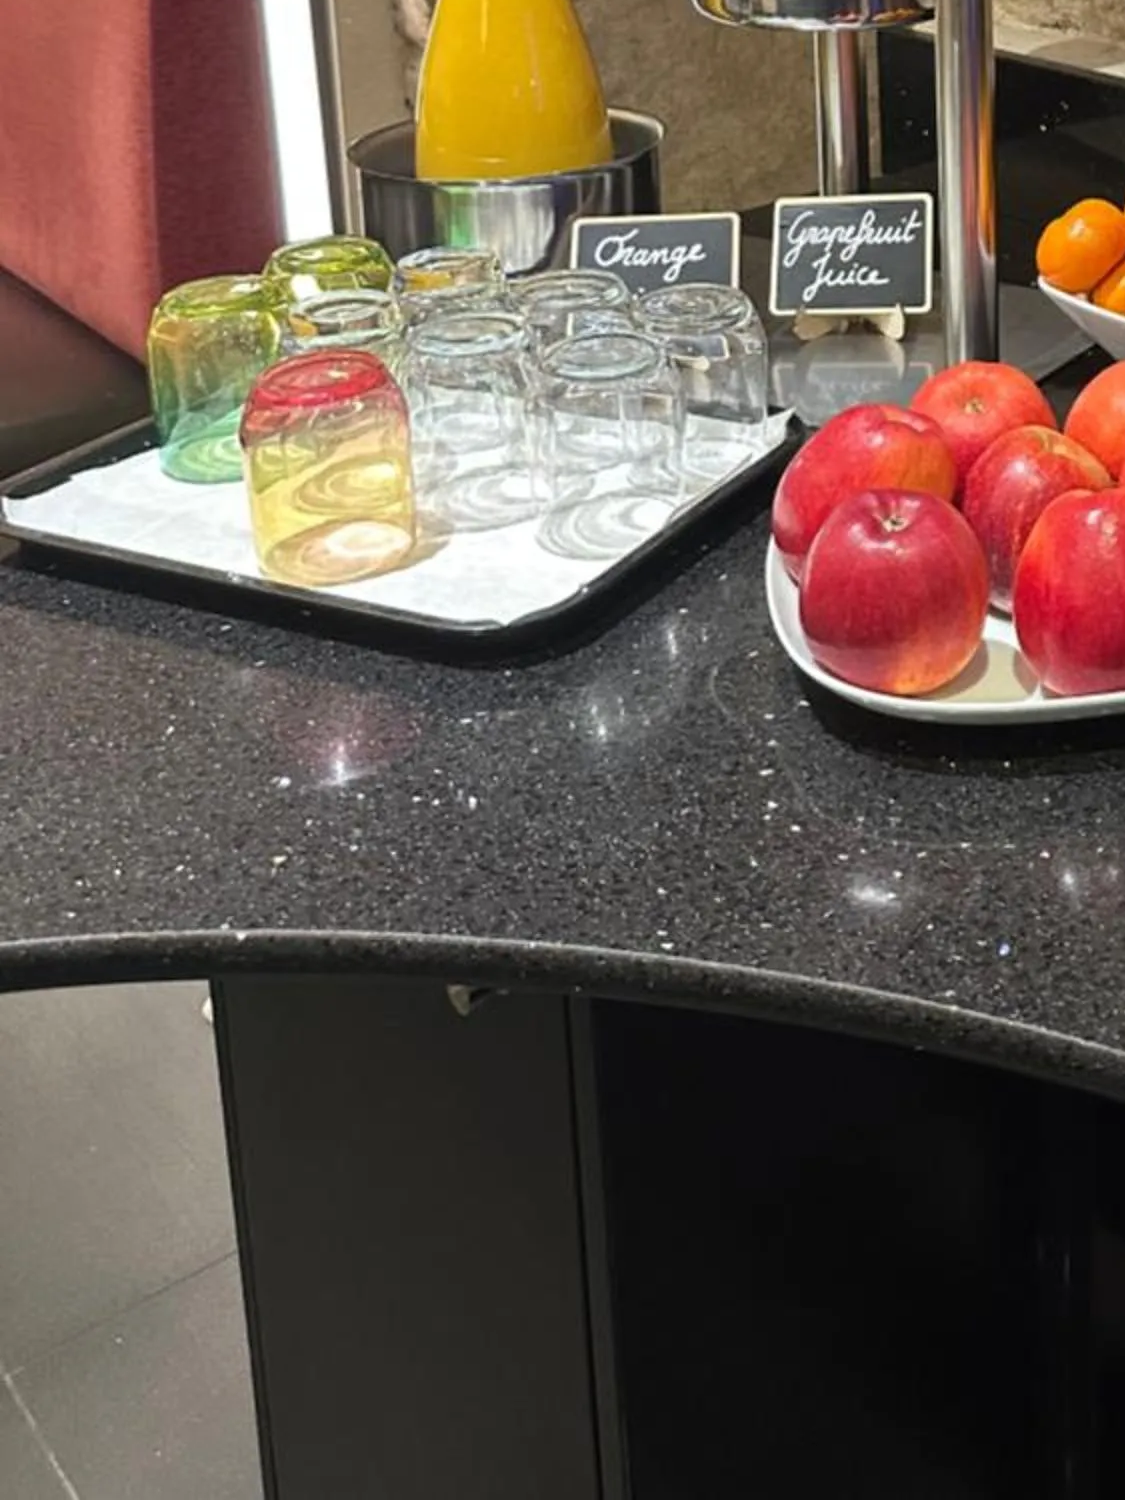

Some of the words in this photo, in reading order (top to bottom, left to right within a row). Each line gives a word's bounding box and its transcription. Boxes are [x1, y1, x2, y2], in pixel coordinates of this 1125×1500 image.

[593, 227, 707, 282] Orange
[783, 209, 922, 266] Grapefruit
[802, 254, 890, 303] Juice
